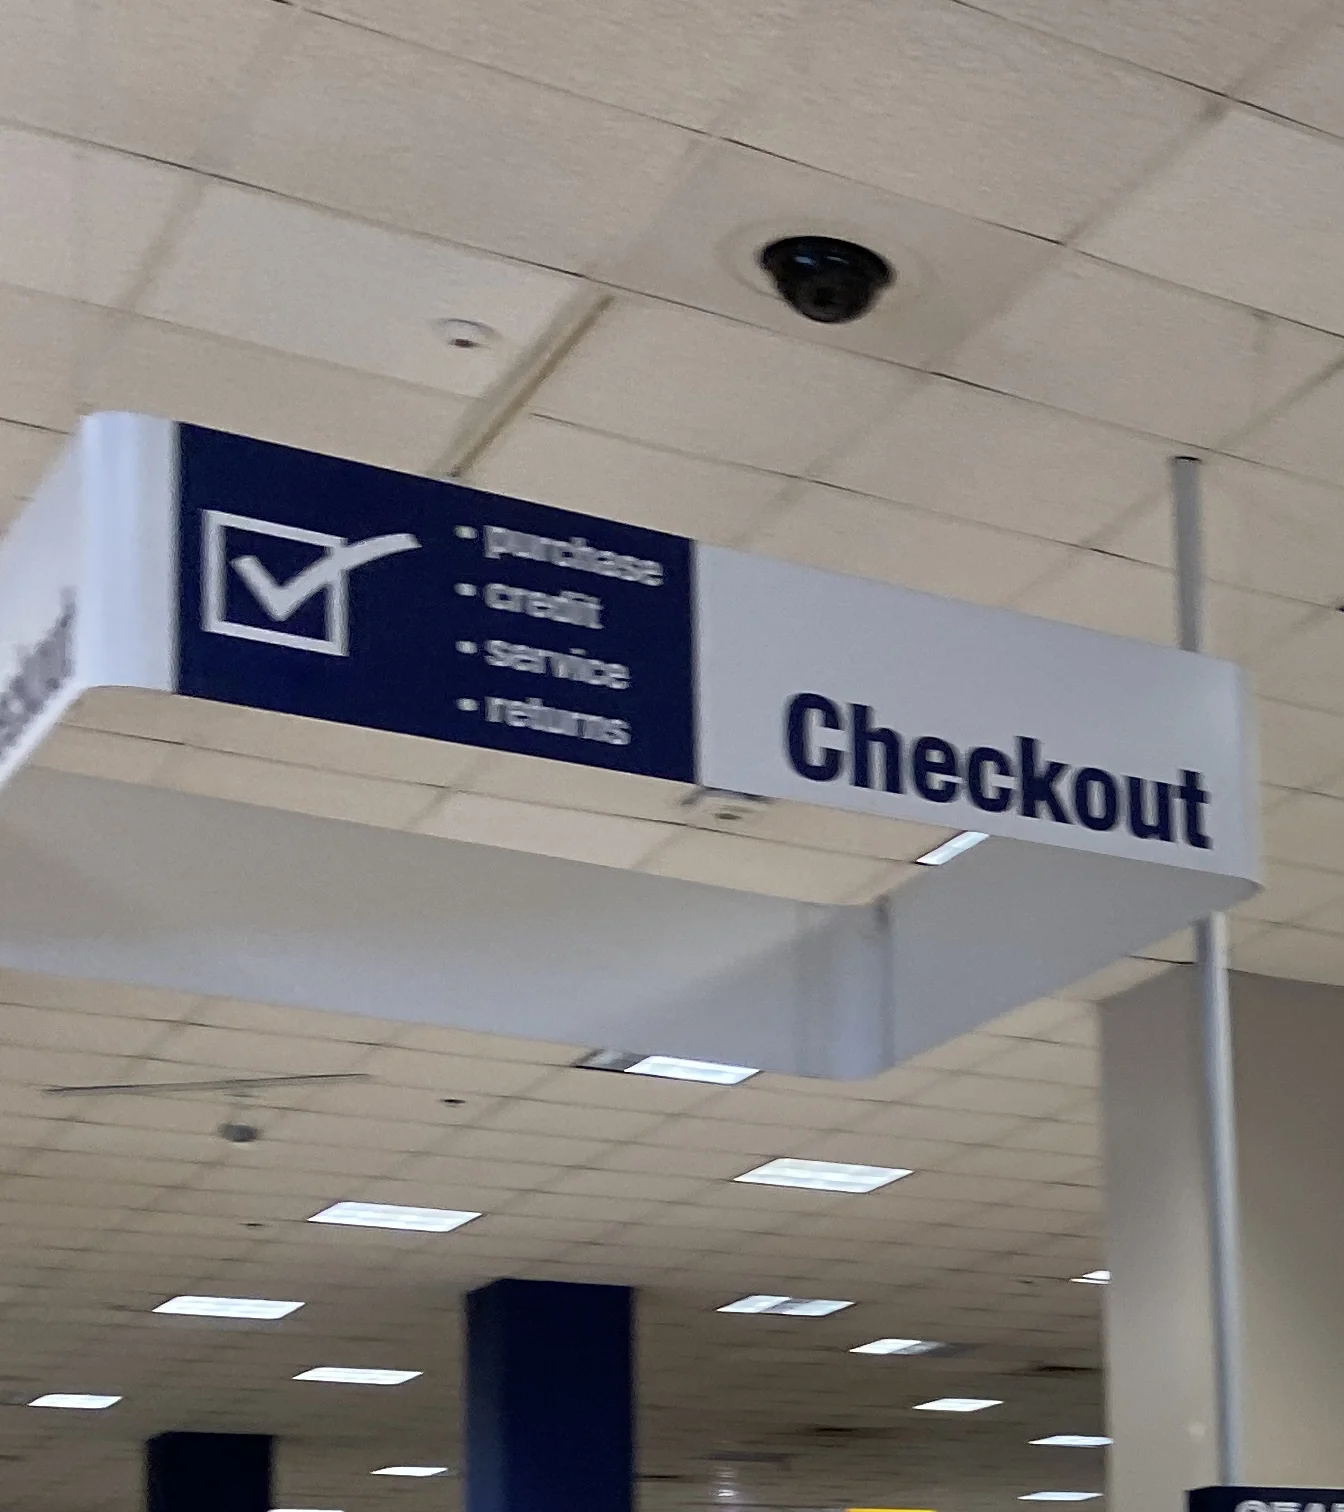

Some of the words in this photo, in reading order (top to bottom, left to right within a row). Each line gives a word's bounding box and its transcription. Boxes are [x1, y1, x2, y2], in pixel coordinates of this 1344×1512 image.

[483, 523, 665, 587] purchase
[484, 580, 605, 630] credit
[484, 637, 632, 690] service
[484, 695, 632, 746] returns
[782, 690, 1213, 849] Checkout
